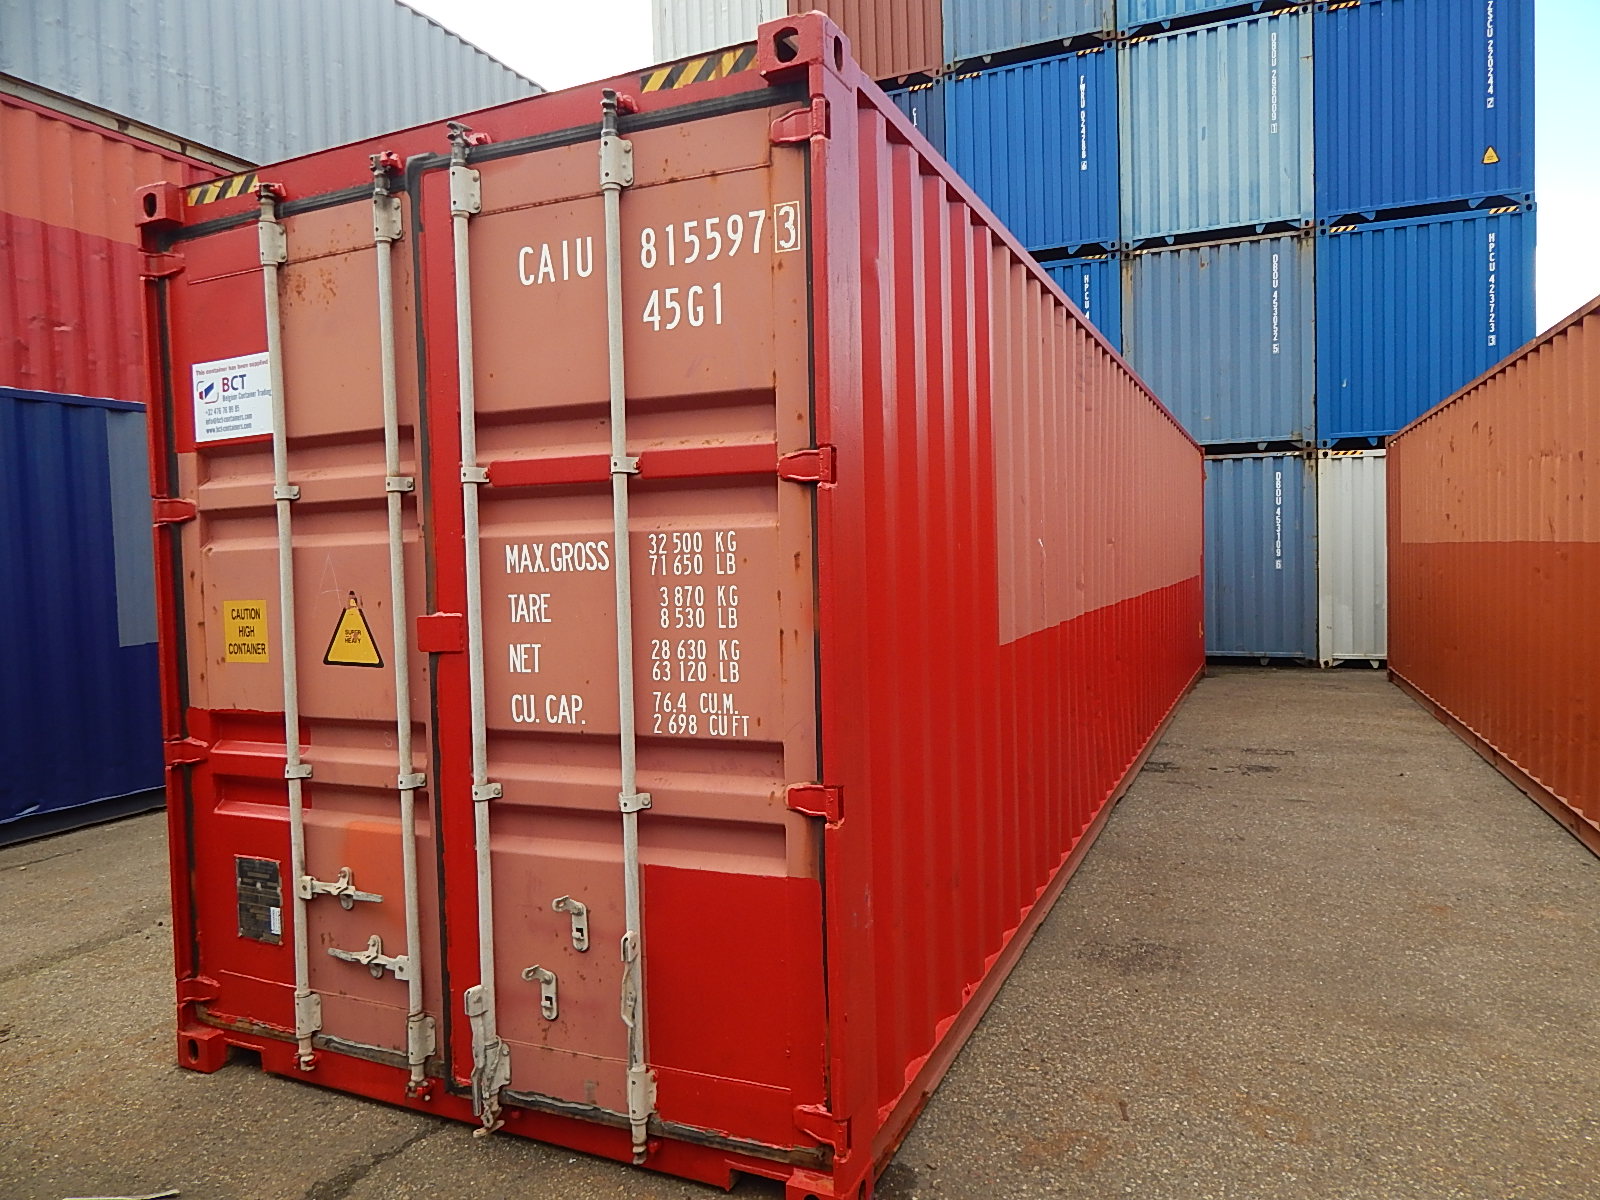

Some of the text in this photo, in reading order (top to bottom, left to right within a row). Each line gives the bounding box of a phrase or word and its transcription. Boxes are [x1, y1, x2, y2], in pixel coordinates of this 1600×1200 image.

[518, 236, 593, 286] CAIU
[1488, 232, 1496, 272] HPCU
[642, 282, 722, 331] 45G1
[1488, 273, 1496, 333] 423723
[222, 374, 247, 393] BCT
[715, 530, 737, 553] KG
[716, 553, 736, 575] LB
[231, 608, 261, 620] CAUTION
[507, 593, 552, 623] TARE
[717, 584, 738, 607] KG
[717, 607, 738, 629] LB
[238, 626, 255, 638] HIGH
[228, 642, 267, 655] CONTAINER
[509, 643, 542, 673] NET
[718, 639, 740, 661] KG
[719, 661, 740, 683] LB
[511, 691, 739, 725] CU. CAP. 76.4 CU.M.
